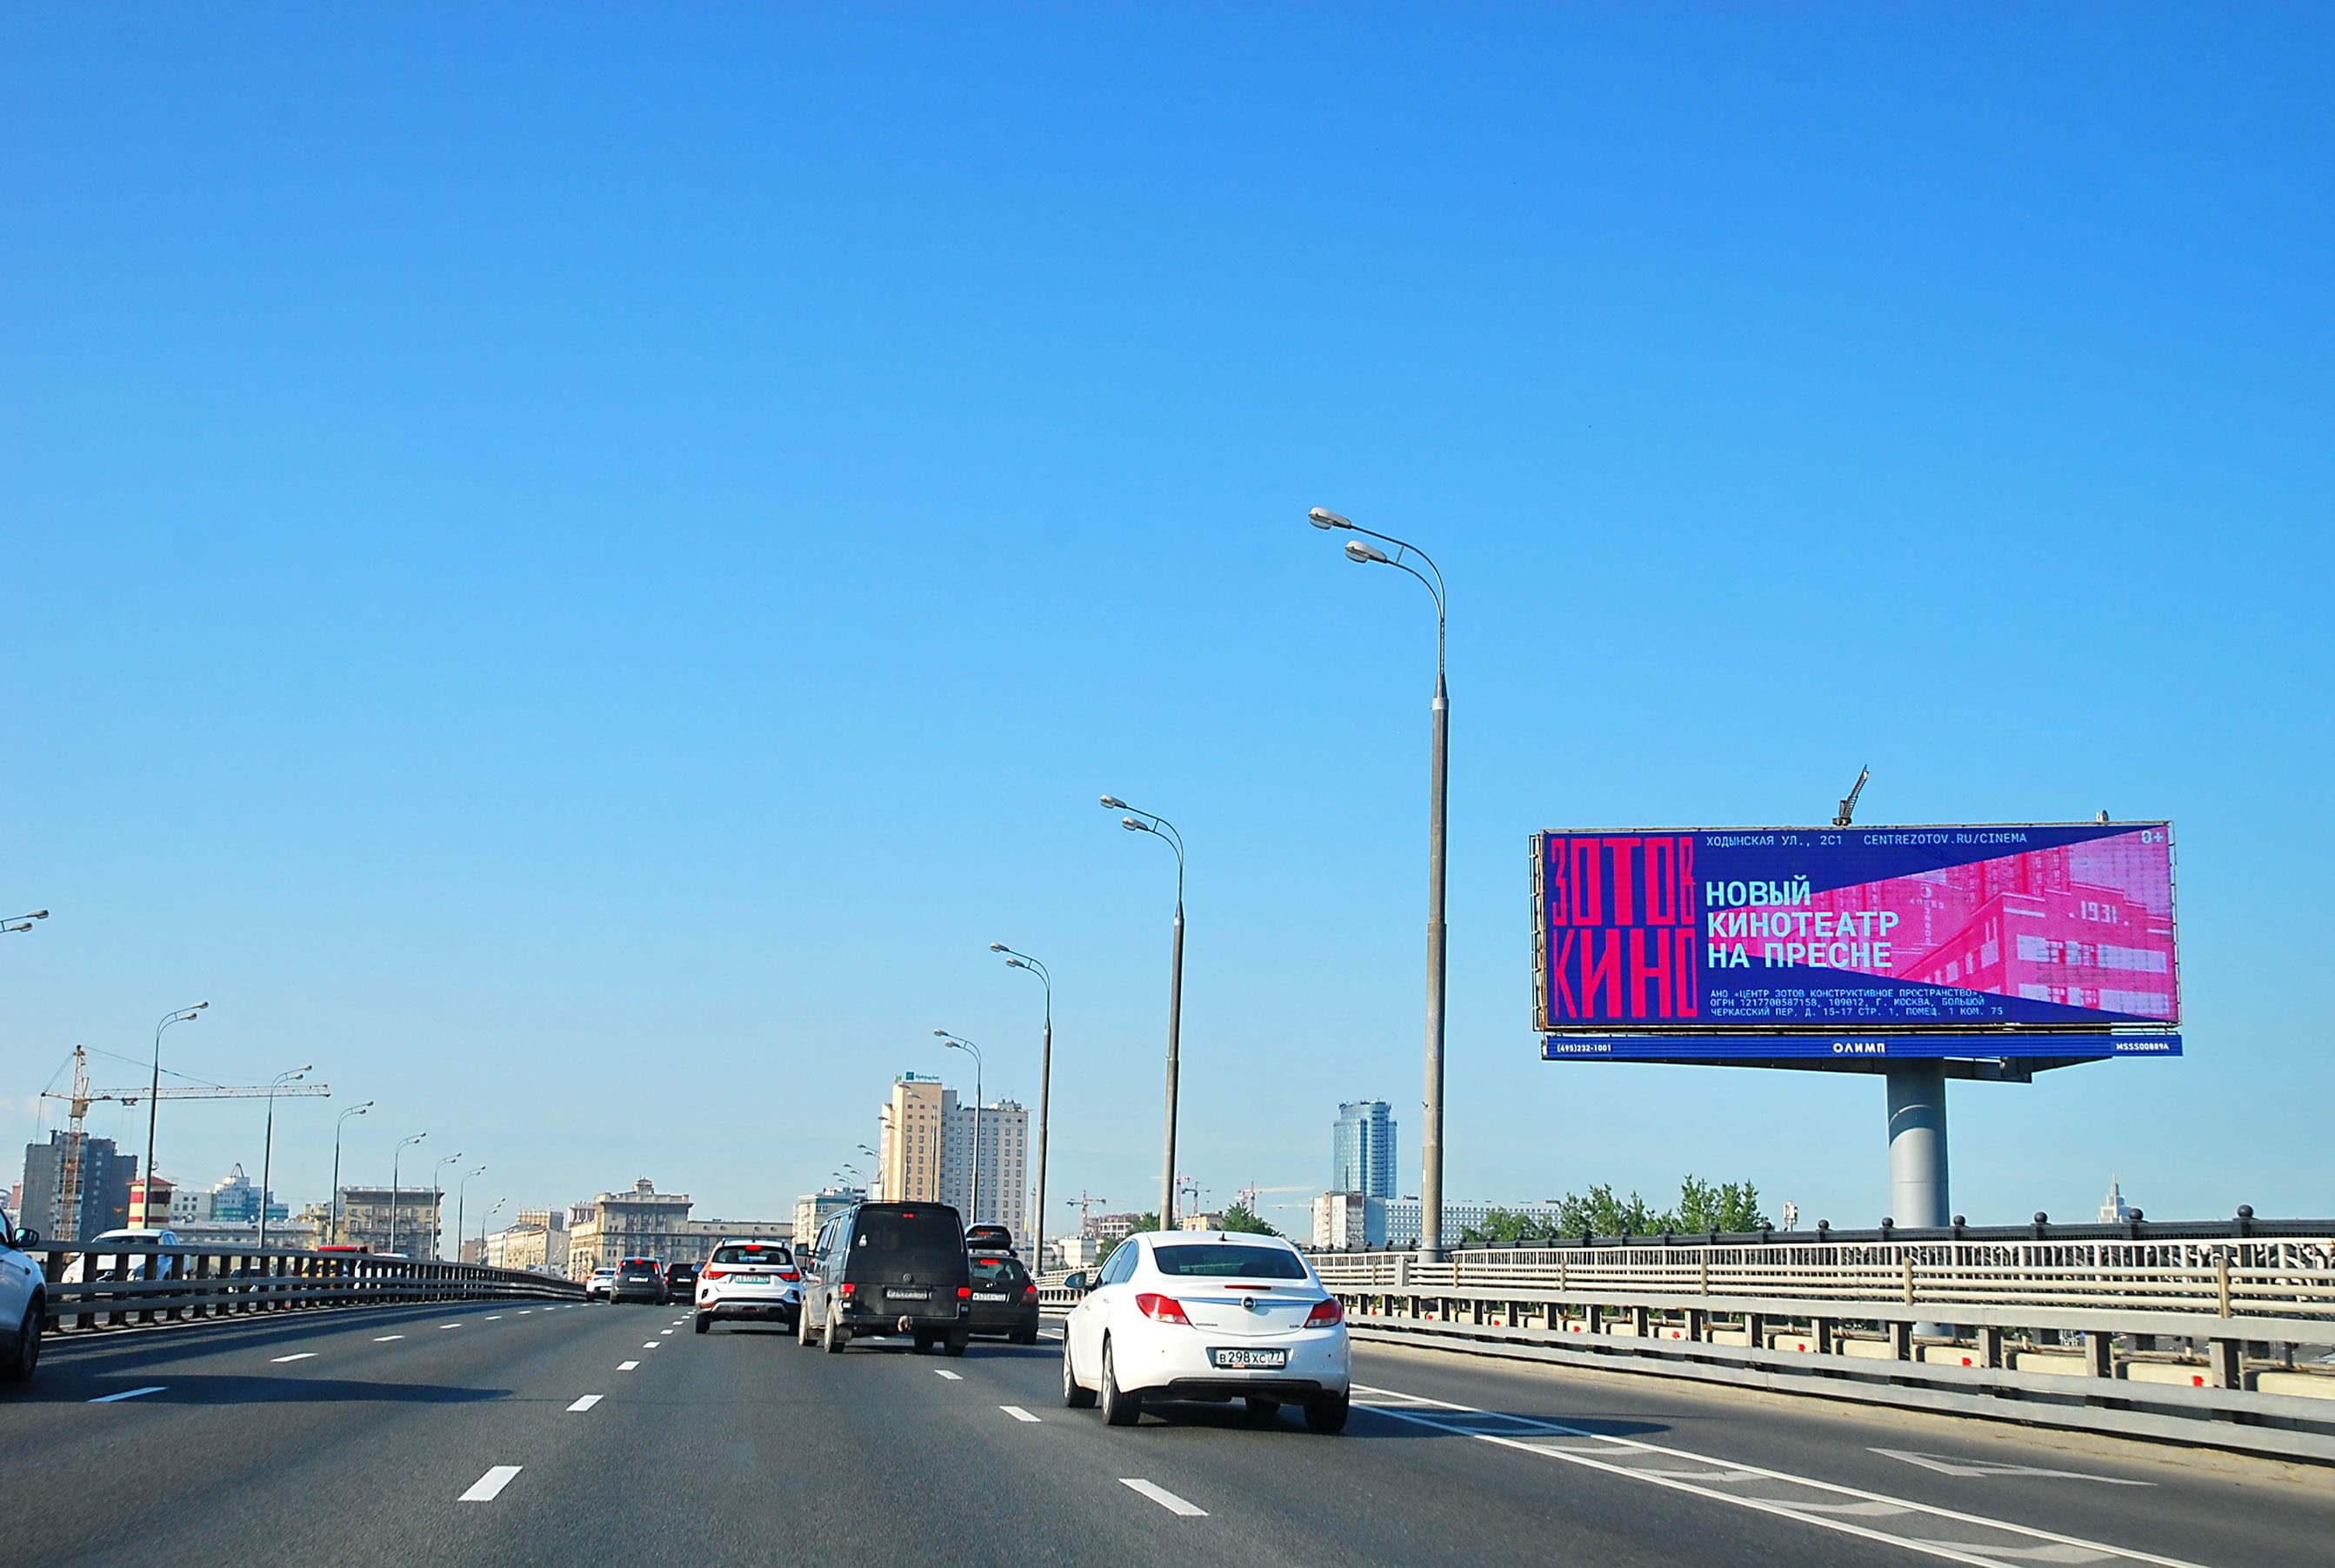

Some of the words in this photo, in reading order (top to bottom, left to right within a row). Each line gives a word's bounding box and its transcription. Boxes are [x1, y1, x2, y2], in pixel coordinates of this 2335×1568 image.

[1706, 835, 1774, 848] ХОДЫНСКАЯ
[1782, 835, 1810, 847] УЛ.,
[1864, 833, 2027, 845] CENTREZOTOV.RU/CINEMA
[2141, 830, 2164, 844] 0+
[1551, 837, 1695, 925] ЗОТОВ
[1706, 874, 1811, 906] НОВЫЙ
[1707, 911, 1899, 937] КИНОТЕАТР
[1708, 943, 1751, 968] НА
[1765, 942, 1892, 968] ПРЕСНЕ
[1552, 928, 1698, 1018] КИНО
[1775, 989, 1805, 998] ЗОТОВ
[1810, 989, 1893, 998] КОНСТРУКТИВНОЕ
[1941, 998, 1985, 1006] БОЛЬШОЙ
[1711, 1007, 1771, 1016] ЧЕРКАССКИЙ
[1824, 1007, 1852, 1016] 15-17
[1557, 1044, 1611, 1052] (495)232-1001
[1832, 1043, 1885, 1053] ОЛИМП
